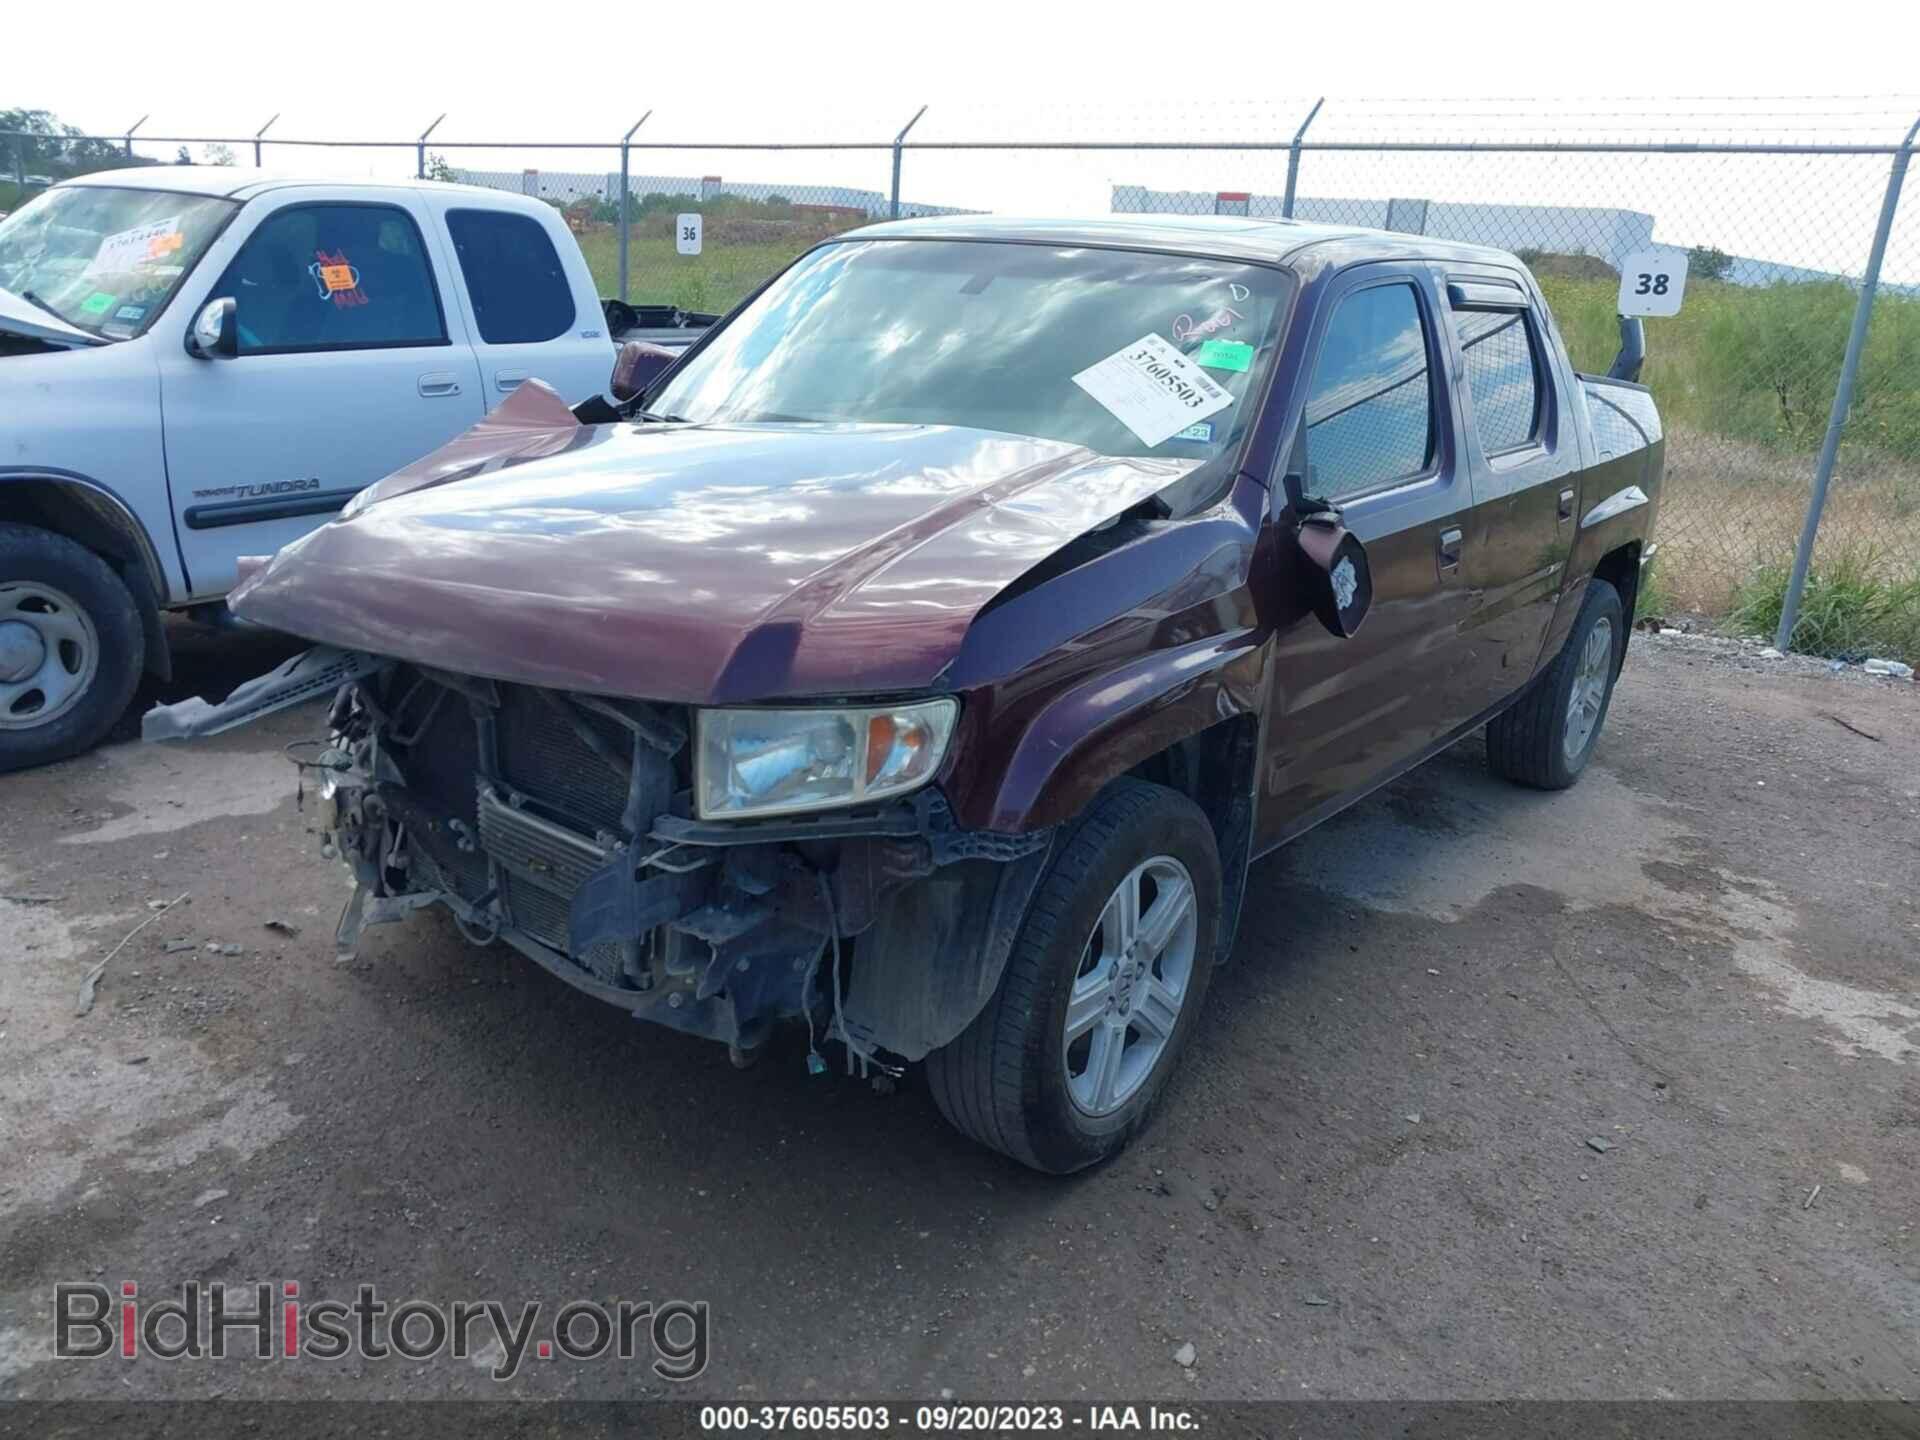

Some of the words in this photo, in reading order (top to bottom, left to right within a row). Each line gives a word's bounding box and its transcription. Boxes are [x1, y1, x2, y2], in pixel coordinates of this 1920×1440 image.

[682, 226, 696, 241] 36
[1635, 273, 1670, 296] 38
[1128, 350, 1205, 408] 37605503
[238, 478, 321, 499] TUNDRA
